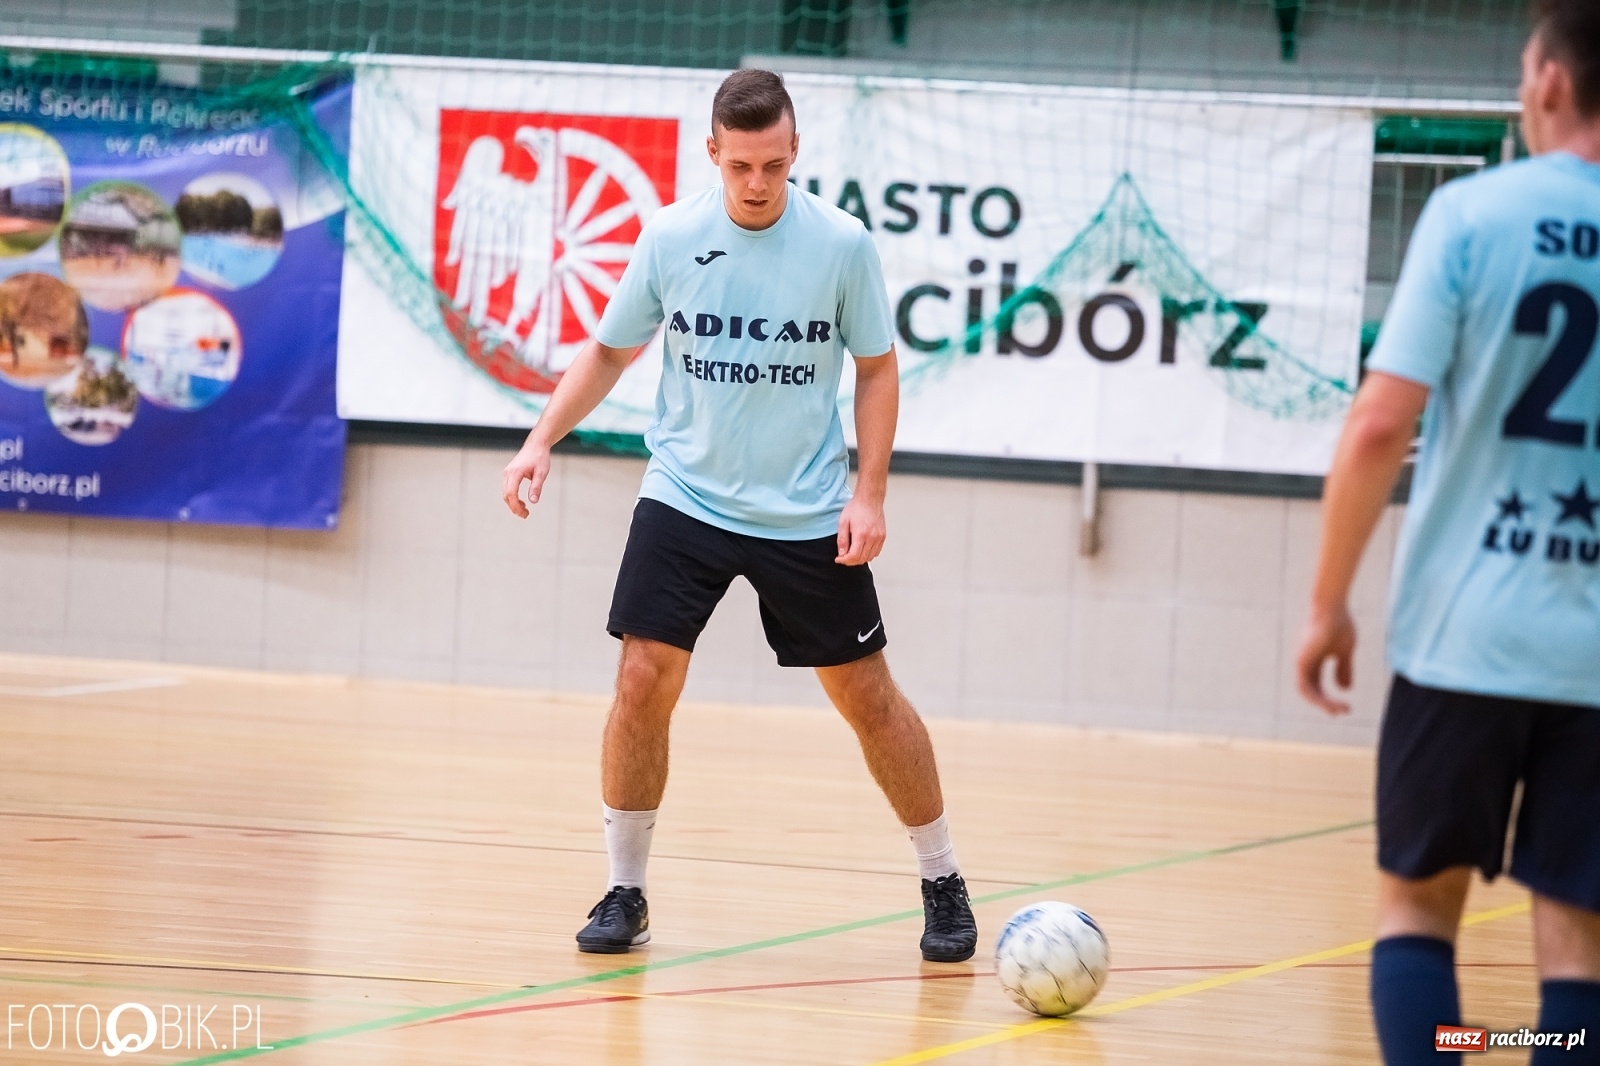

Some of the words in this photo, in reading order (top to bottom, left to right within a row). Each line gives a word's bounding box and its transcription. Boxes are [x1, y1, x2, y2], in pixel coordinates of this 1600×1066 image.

[39, 87, 128, 121] Sportu
[787, 177, 1021, 238] ASTO
[669, 310, 831, 344] ADICAR
[896, 259, 1268, 370] cibórz
[1502, 280, 1600, 446] 2
